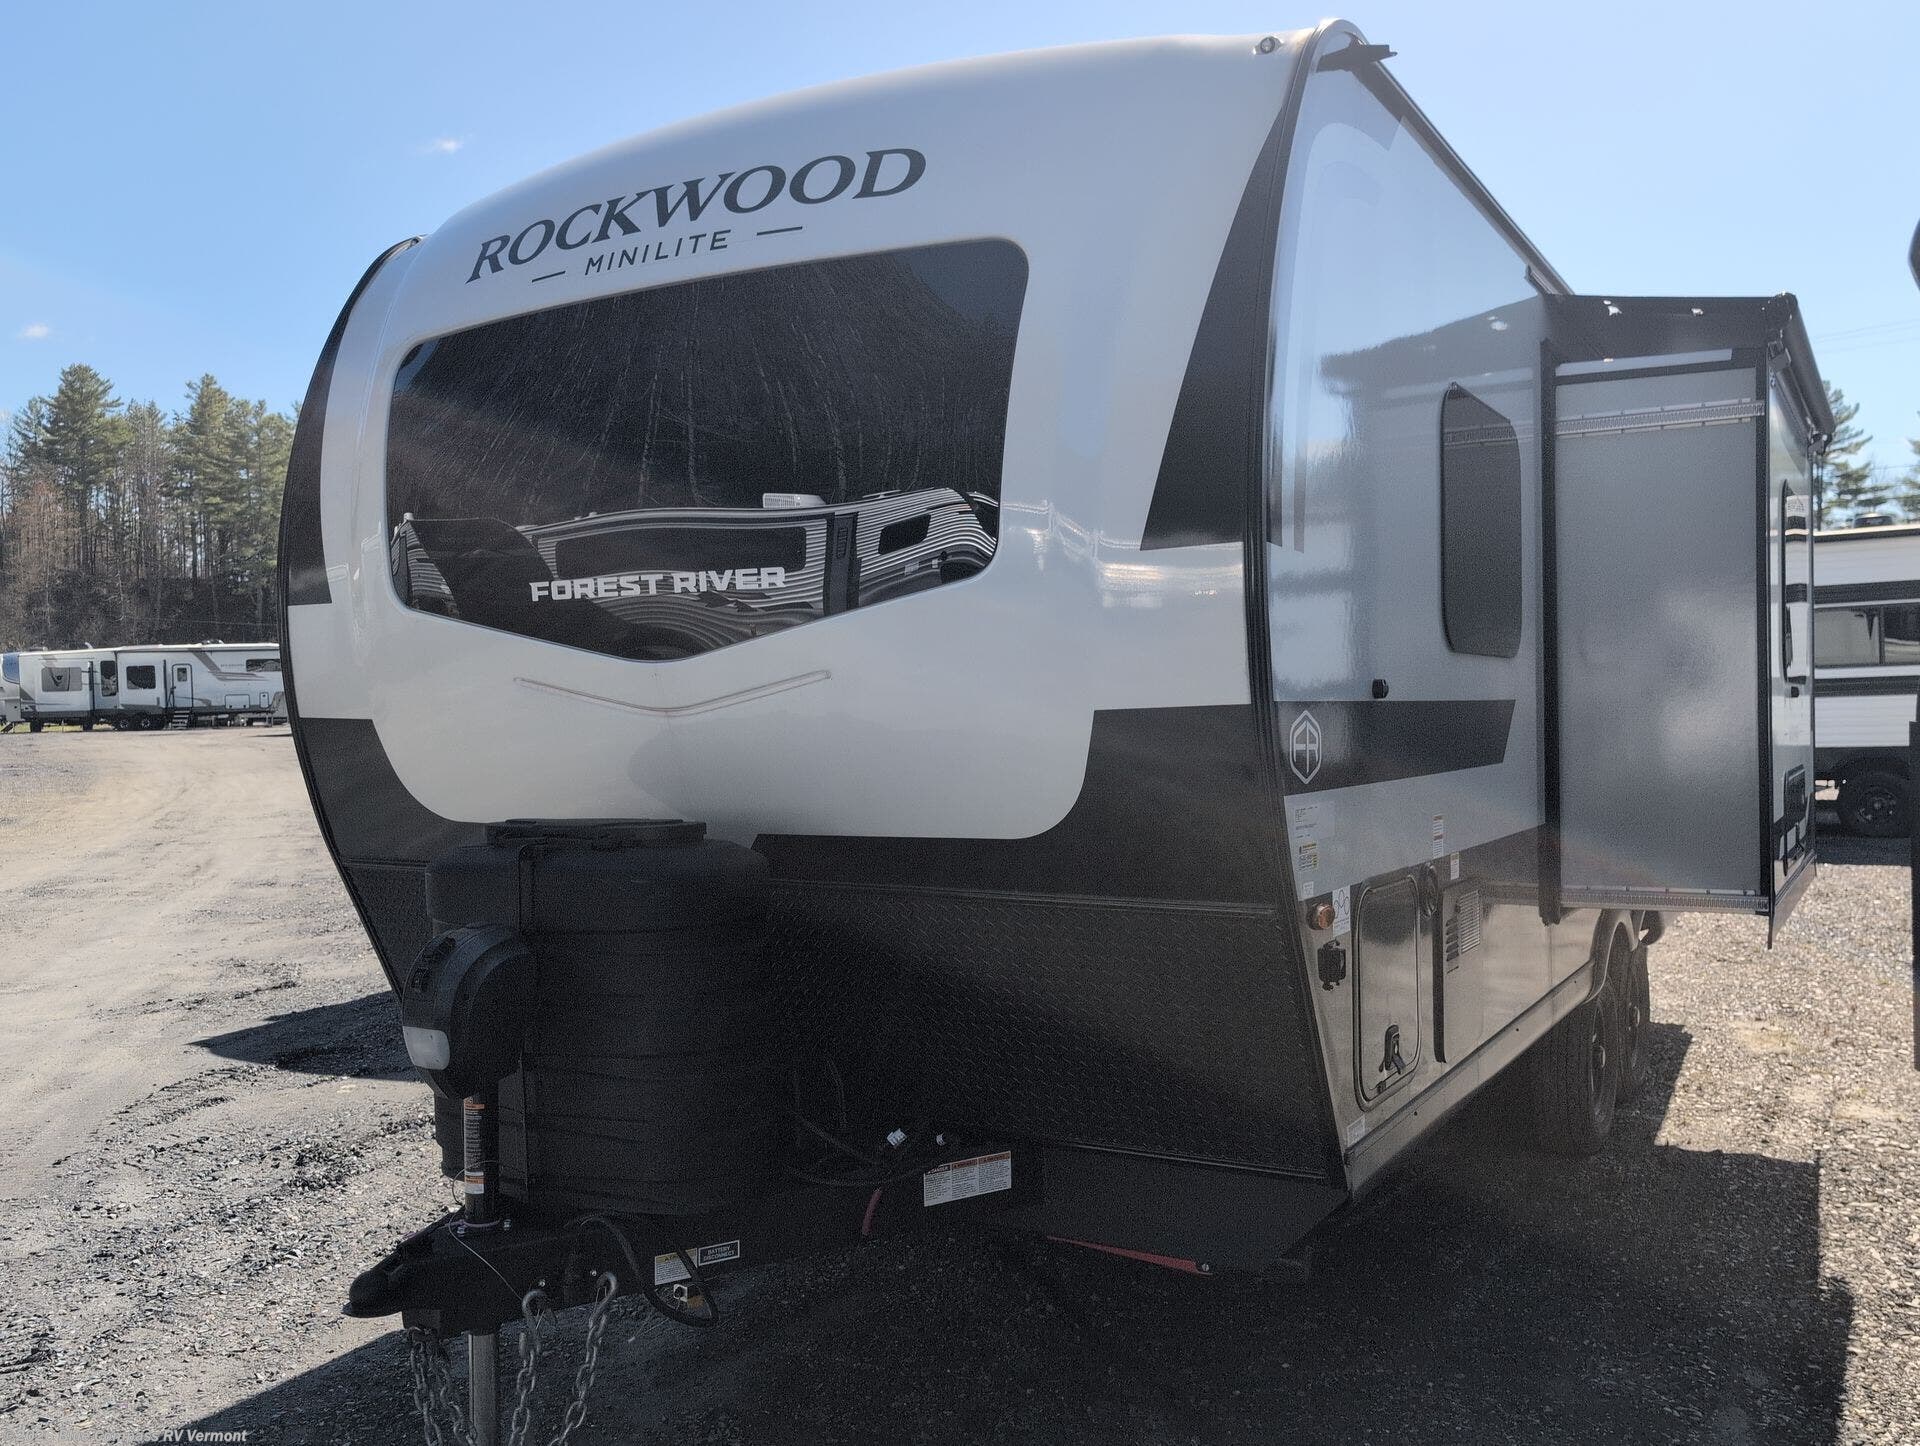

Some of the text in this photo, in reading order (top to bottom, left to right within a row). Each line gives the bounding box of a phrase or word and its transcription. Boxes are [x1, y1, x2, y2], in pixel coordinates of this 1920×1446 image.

[464, 147, 927, 284] ROCKWOOD
[584, 229, 731, 276] MINILITE
[529, 566, 786, 602] FOREST RIVER
